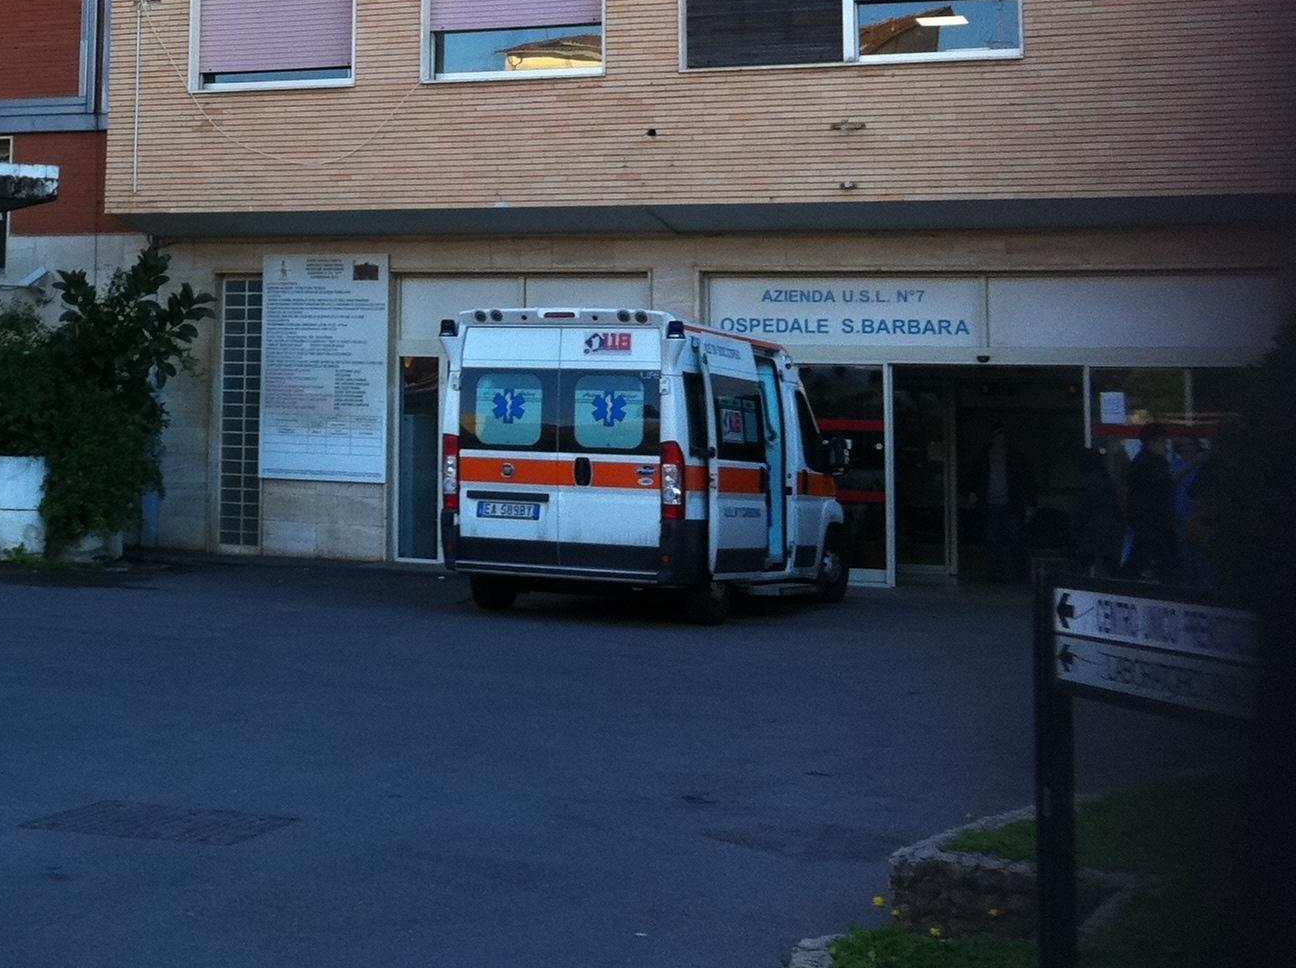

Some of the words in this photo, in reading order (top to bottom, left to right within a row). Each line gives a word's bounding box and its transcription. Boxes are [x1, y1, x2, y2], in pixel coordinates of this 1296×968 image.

[761, 289, 836, 303] AZIENDA
[842, 289, 890, 303] U.S.L.
[897, 289, 925, 303] N°7
[720, 317, 829, 334] OSPEDALE
[841, 318, 971, 336] S.BARBARA
